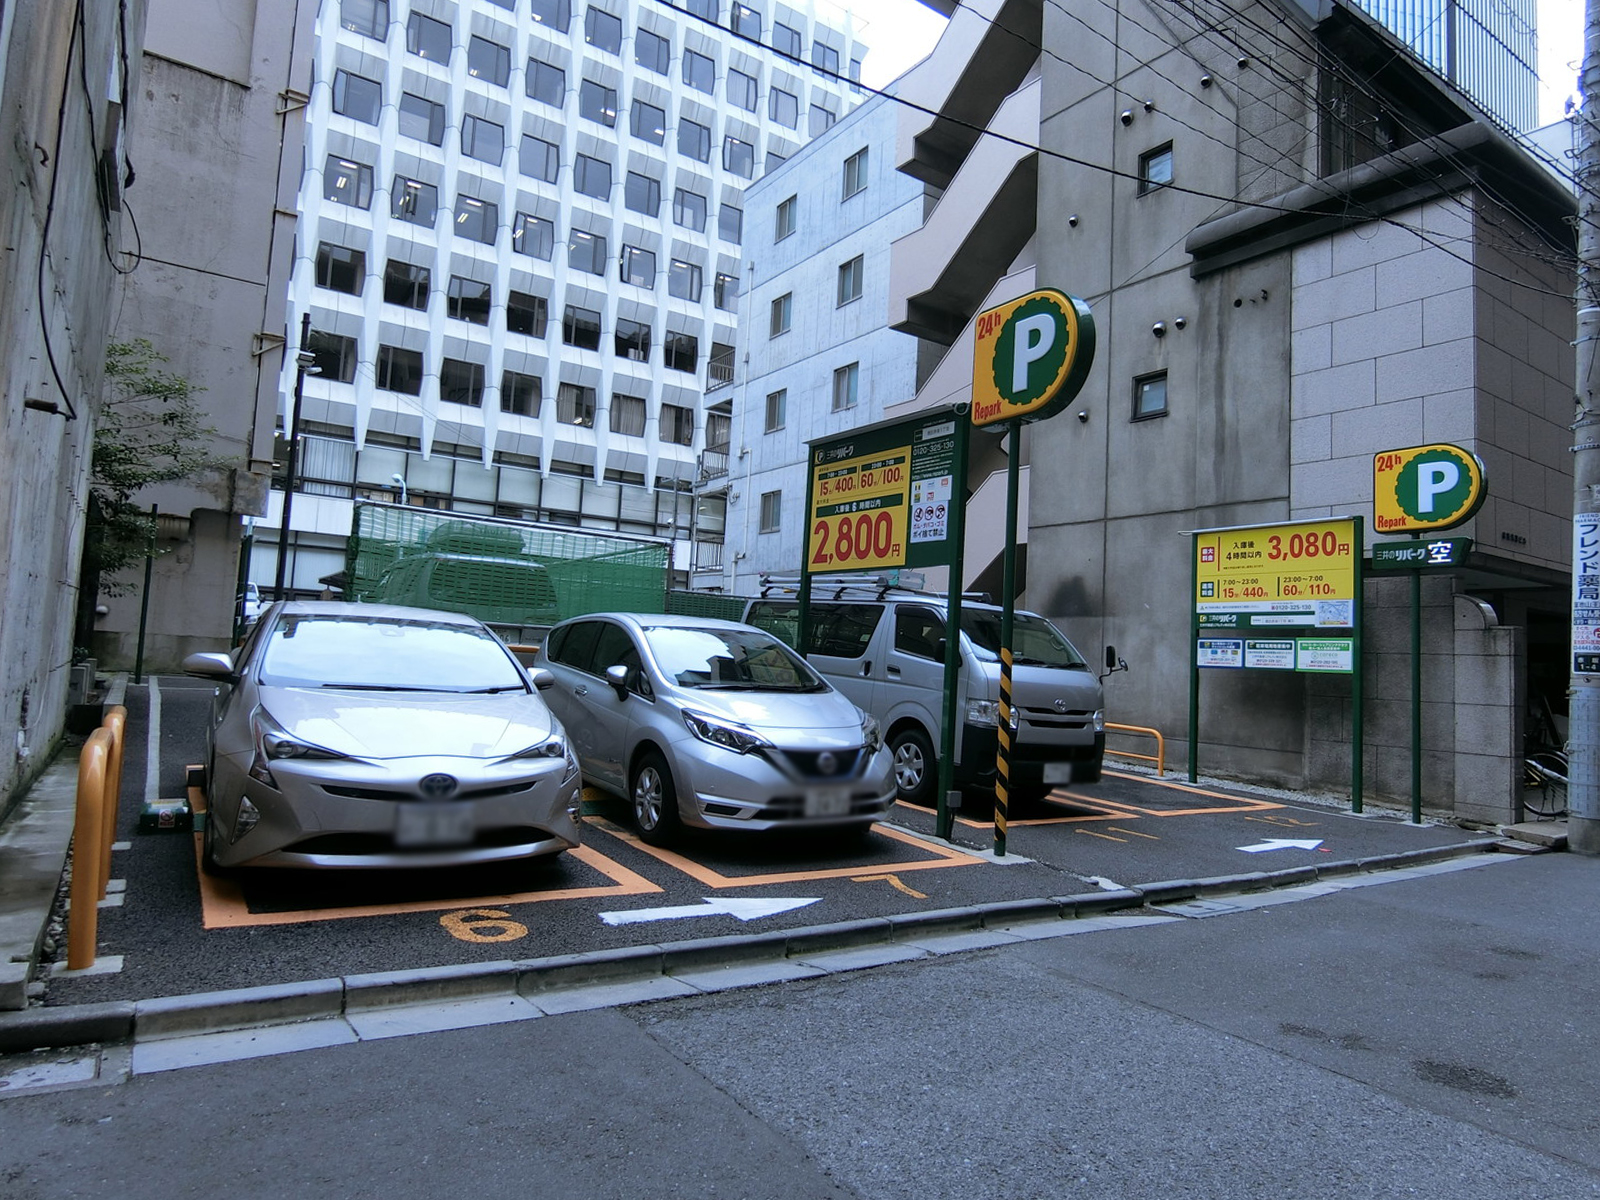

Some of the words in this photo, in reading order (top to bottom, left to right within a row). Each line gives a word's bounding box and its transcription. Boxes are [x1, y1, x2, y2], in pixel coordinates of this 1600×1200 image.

[978, 312, 1001, 340] 24h
[1012, 313, 1056, 393] P
[974, 400, 1002, 421] Repark
[912, 440, 955, 456] 0120-325-130
[1377, 454, 1402, 472] 24h
[1418, 461, 1459, 513] P
[1377, 515, 1407, 529] Repark
[812, 511, 900, 565] 2,800円
[1267, 531, 1350, 561] 3,080円
[1226, 550, 1262, 561] 4時間以内
[1427, 541, 1452, 564] 空
[1577, 524, 1600, 600] フレンド薬局
[850, 873, 930, 899] 7
[439, 908, 529, 944] 6
